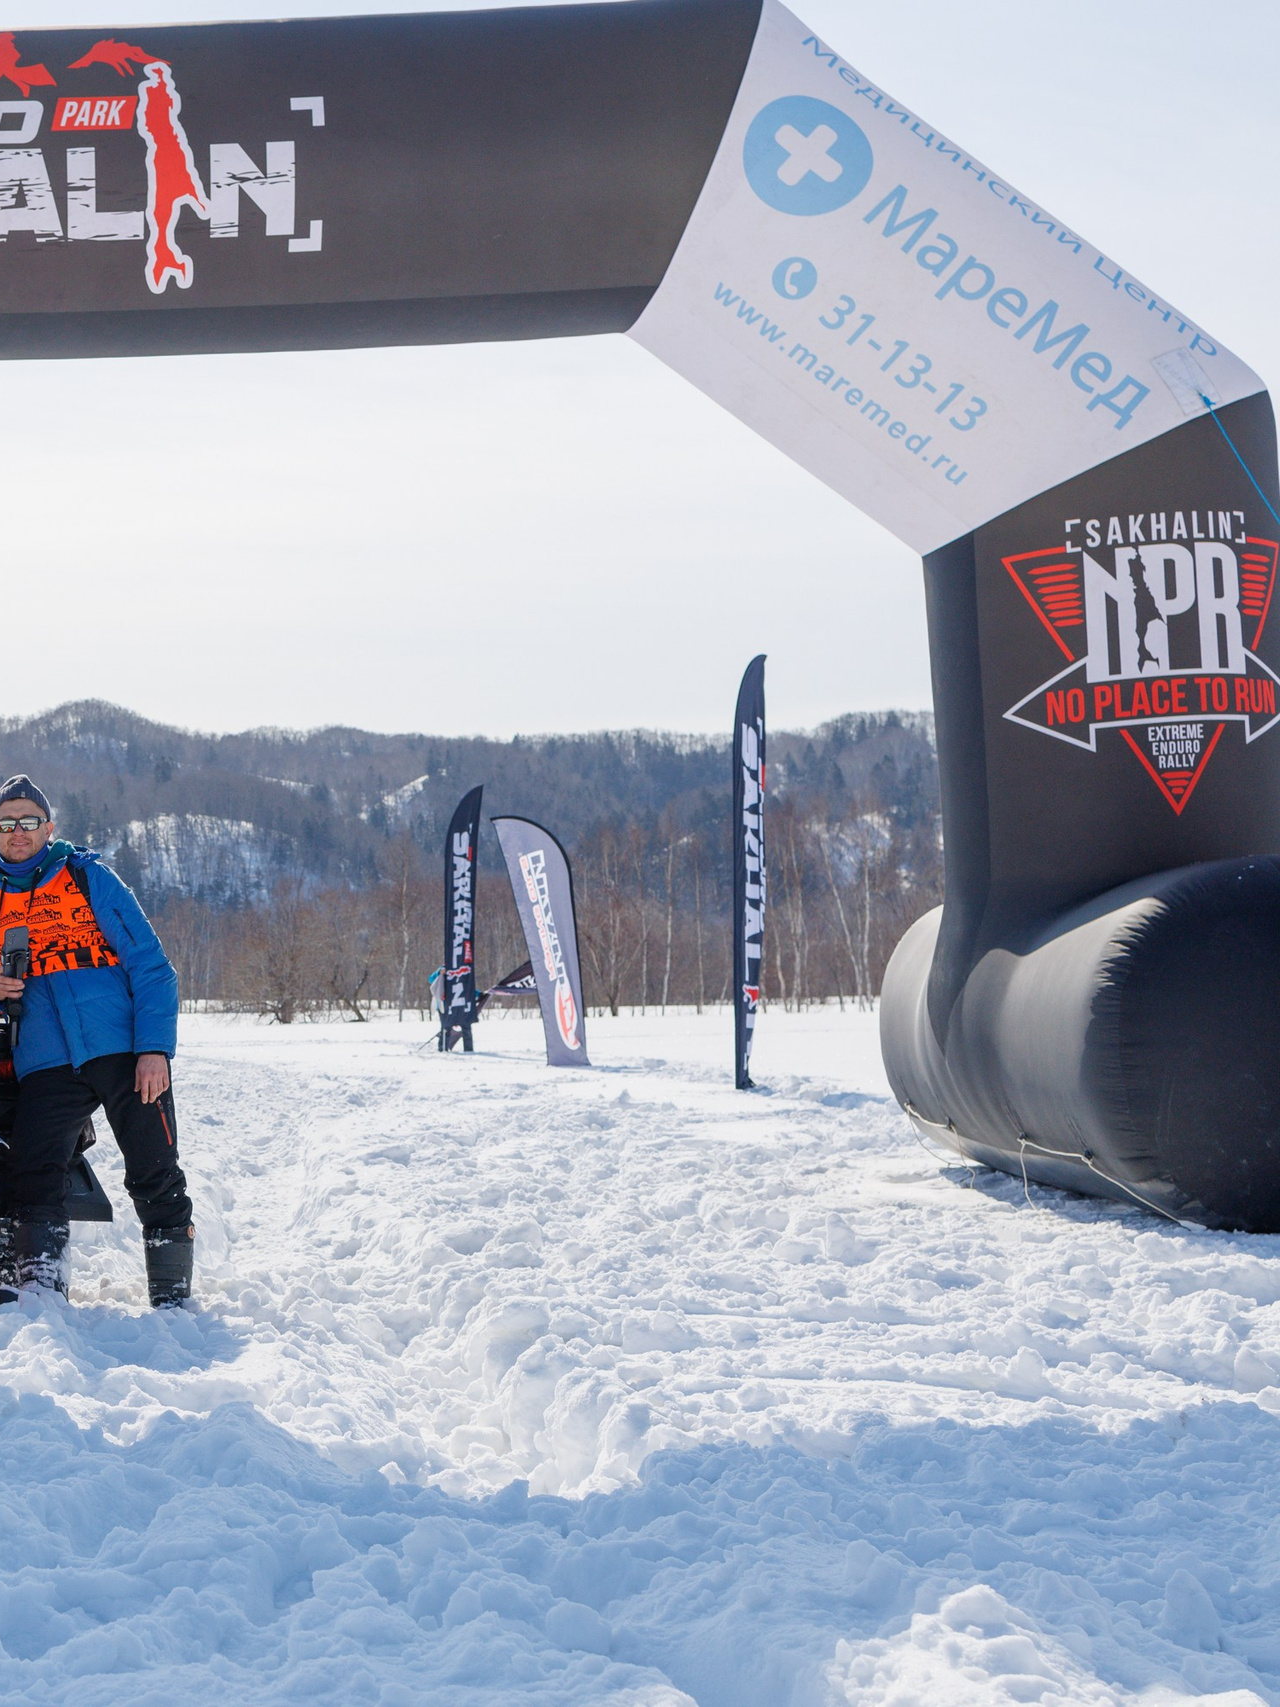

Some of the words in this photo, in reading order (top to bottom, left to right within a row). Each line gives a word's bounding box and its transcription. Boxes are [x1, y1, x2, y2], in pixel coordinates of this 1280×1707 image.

[58, 99, 127, 128] PARK
[801, 35, 1083, 255] Медицинский
[1092, 255, 1218, 357] Центр
[861, 183, 1151, 430] МареМед
[711, 280, 970, 487] www.maremed.ru
[818, 293, 989, 432] 31-13-13
[1084, 509, 1233, 549] SAKHALIN
[1082, 541, 1247, 684] NPR
[1045, 687, 1087, 726] NO
[1093, 677, 1189, 721] PLACE
[1194, 676, 1229, 714] TO
[1234, 677, 1277, 715] RUN
[1147, 723, 1205, 743] EXTREME
[1151, 739, 1201, 757] ENDURO
[1158, 753, 1196, 770] RALLY
